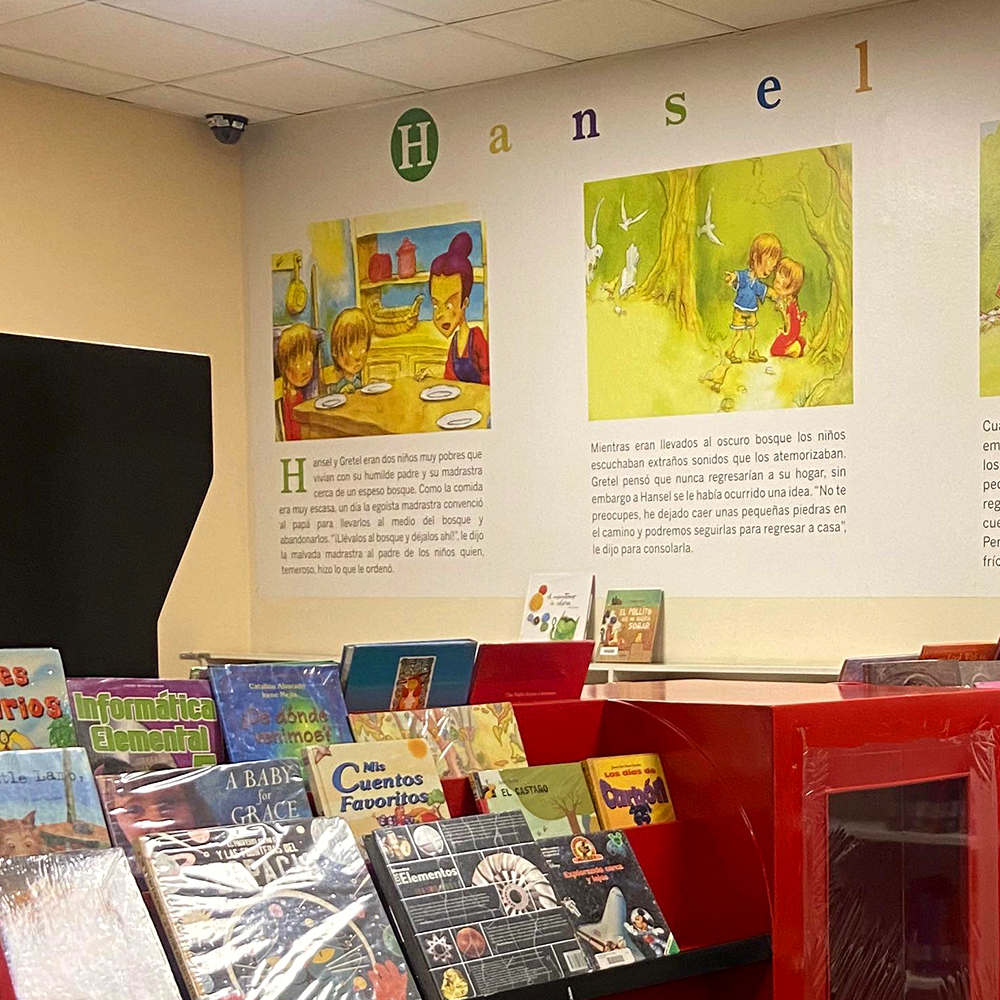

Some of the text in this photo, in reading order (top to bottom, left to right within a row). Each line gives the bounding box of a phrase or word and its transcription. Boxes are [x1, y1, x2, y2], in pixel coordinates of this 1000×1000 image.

[591, 429, 845, 453] Mientras eran llevados al oscuro bosque los niños
[312, 456, 332, 470] ansel
[339, 455, 362, 469] Gretel
[362, 456, 380, 466] eran
[381, 453, 395, 467] dos
[396, 452, 418, 465] niños
[419, 453, 437, 464] muy
[438, 450, 466, 464] pobres
[466, 450, 482, 463] que
[591, 503, 846, 523] preocupes, he dejado caer unas pequeñas piedras en
[317, 562, 333, 574] hizo
[333, 562, 341, 574] lo
[342, 562, 356, 575] que
[357, 561, 364, 574] le
[73, 689, 217, 726] Informática
[89, 724, 211, 754] Elemental
[225, 766, 293, 790] A BABY
[332, 762, 424, 794] Cuentos
[363, 761, 386, 773] Mis
[256, 788, 272, 805] for
[339, 790, 429, 813] Favoritos
[501, 788, 512, 797] EL
[600, 776, 669, 810] Carbón
[231, 800, 301, 825] GRACE
[399, 867, 459, 885] Elementos
